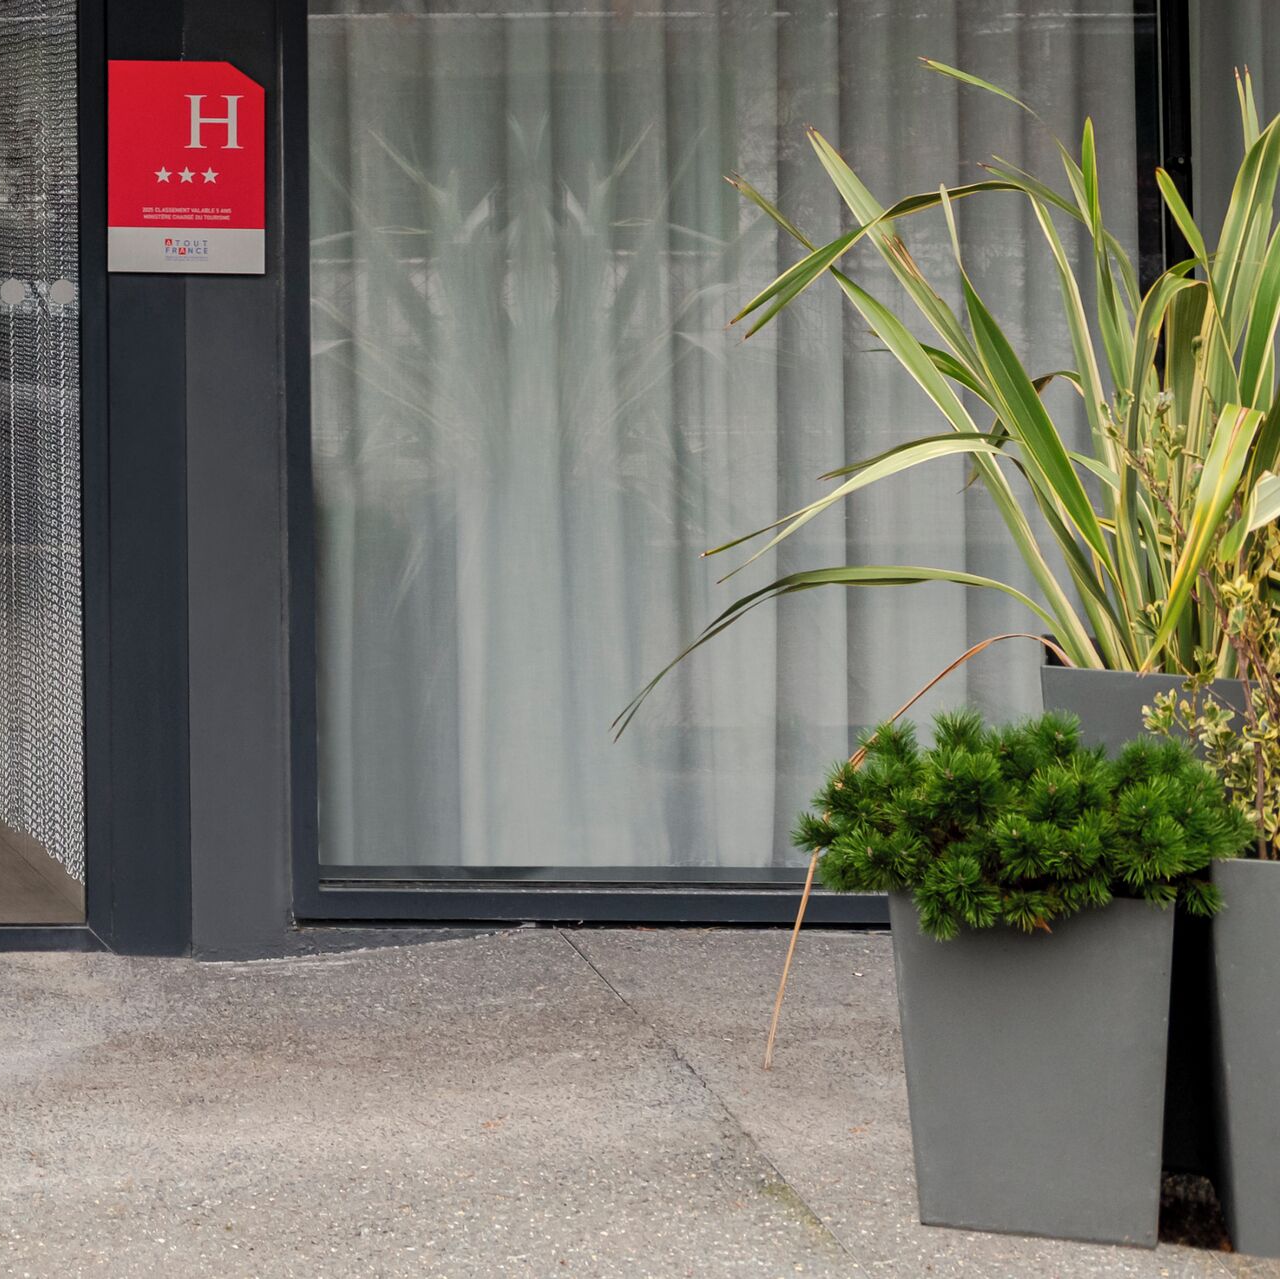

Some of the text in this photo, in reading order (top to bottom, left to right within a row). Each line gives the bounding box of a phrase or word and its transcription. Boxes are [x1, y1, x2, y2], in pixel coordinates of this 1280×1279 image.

[184, 94, 244, 149] H
[191, 207, 215, 215] VALABLE
[164, 247, 208, 255] FRANCE
